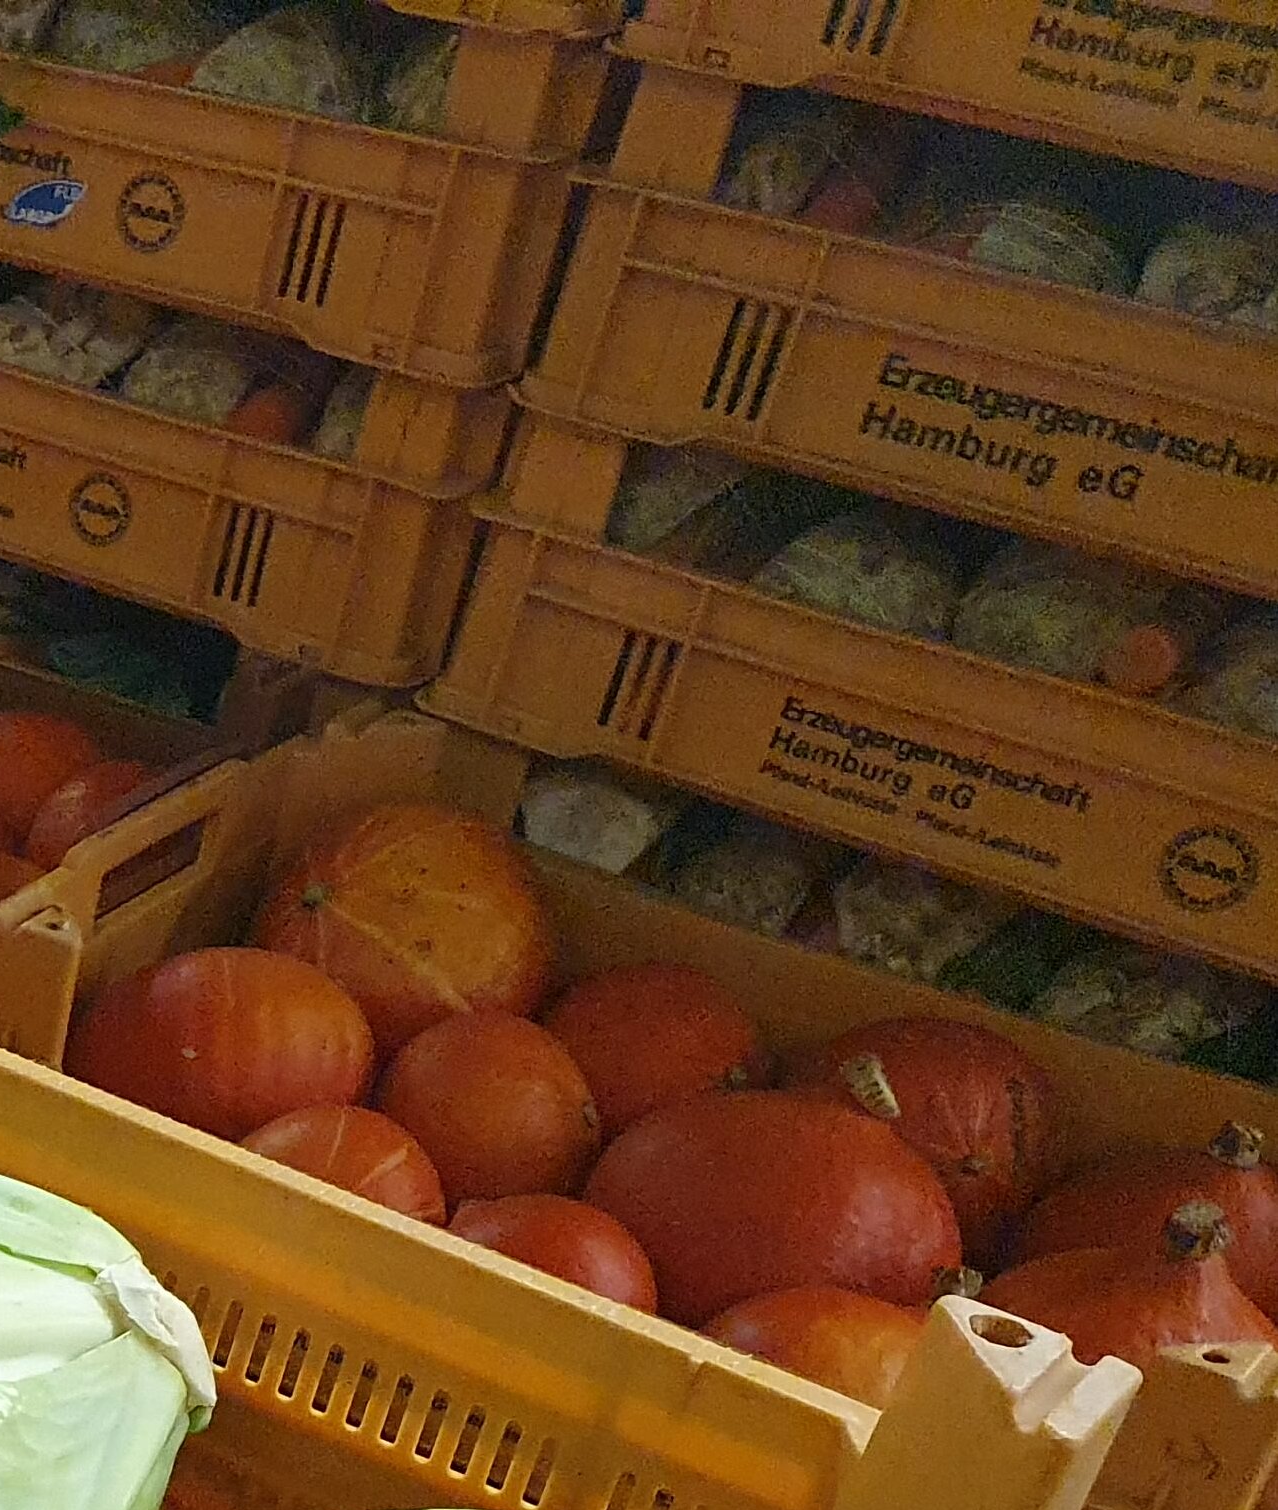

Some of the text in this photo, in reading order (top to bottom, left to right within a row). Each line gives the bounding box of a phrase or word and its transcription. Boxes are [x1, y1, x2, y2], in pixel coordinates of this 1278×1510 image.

[859, 399, 1144, 500] Hamburg eG
[768, 726, 913, 796] Hamburg
[780, 696, 1091, 812] Erzeugergemeinschaft
